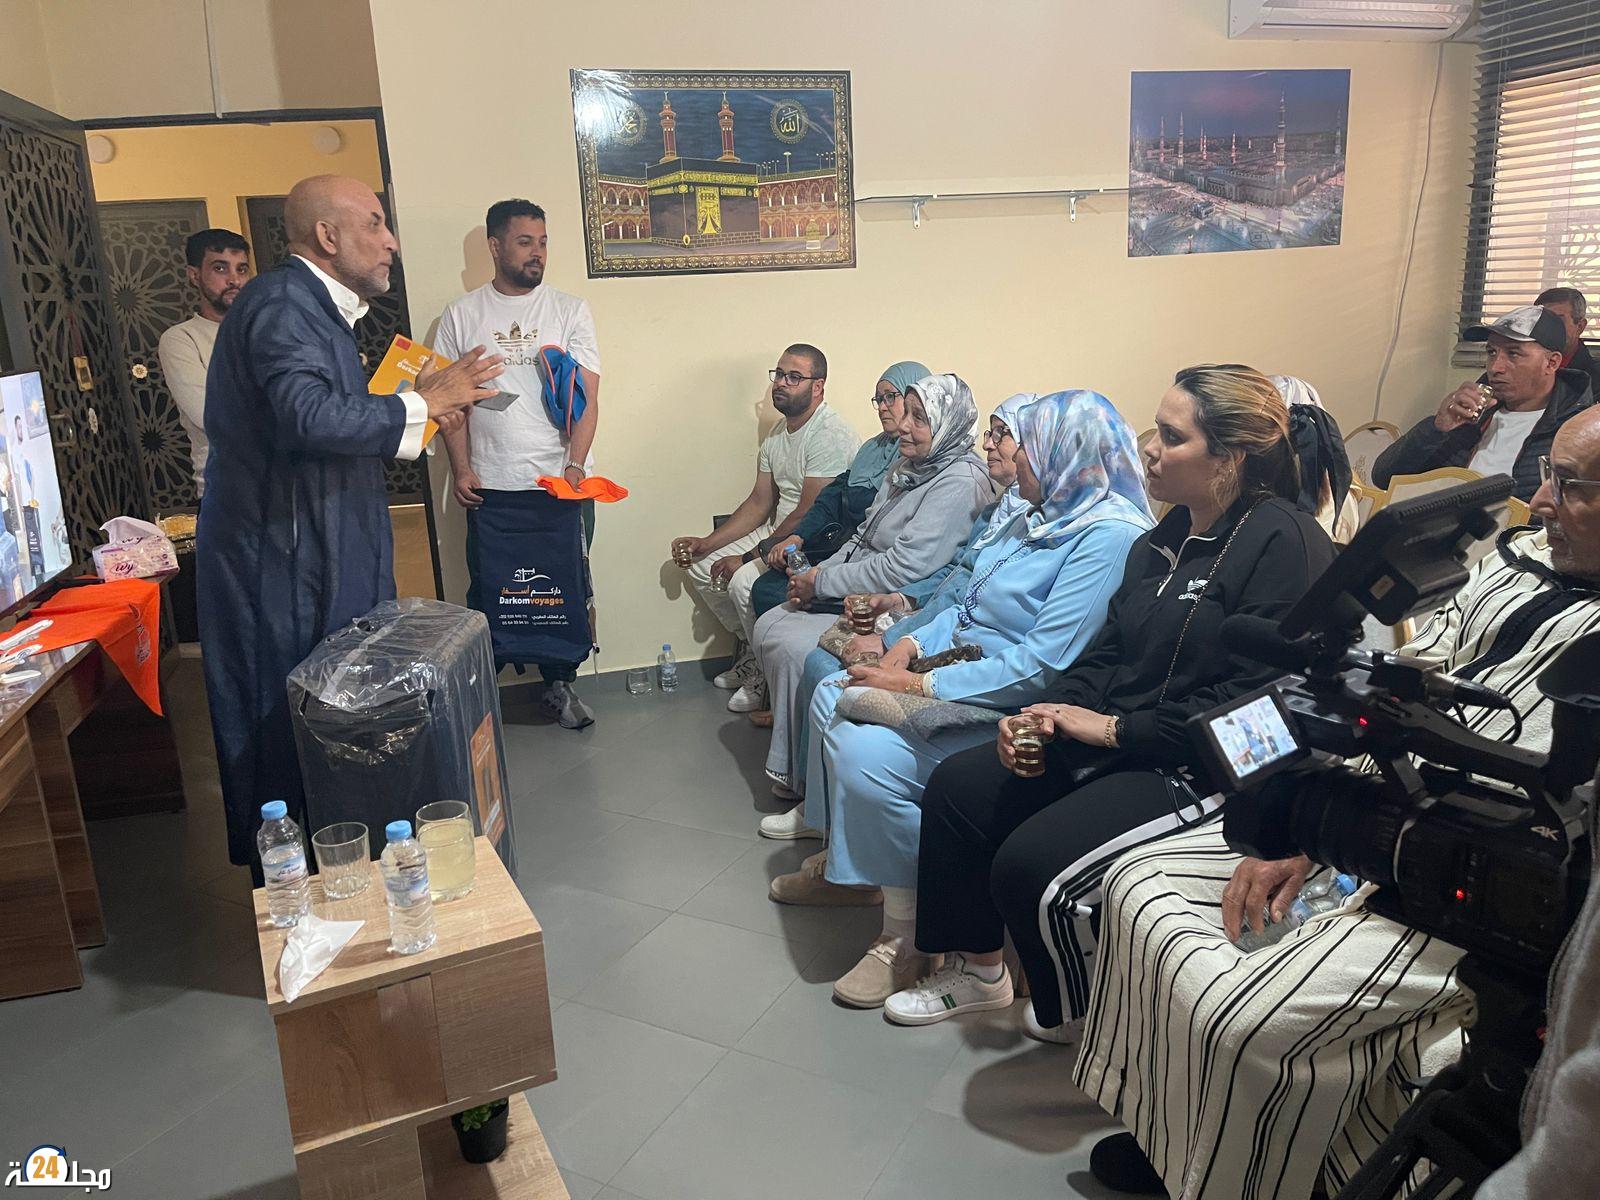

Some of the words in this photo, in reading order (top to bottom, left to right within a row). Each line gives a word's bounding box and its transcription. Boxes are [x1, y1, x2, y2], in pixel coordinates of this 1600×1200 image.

[530, 586, 561, 597] داركم
[499, 596, 564, 606] Darkomvoyages
[1531, 826, 1558, 840] 4K
